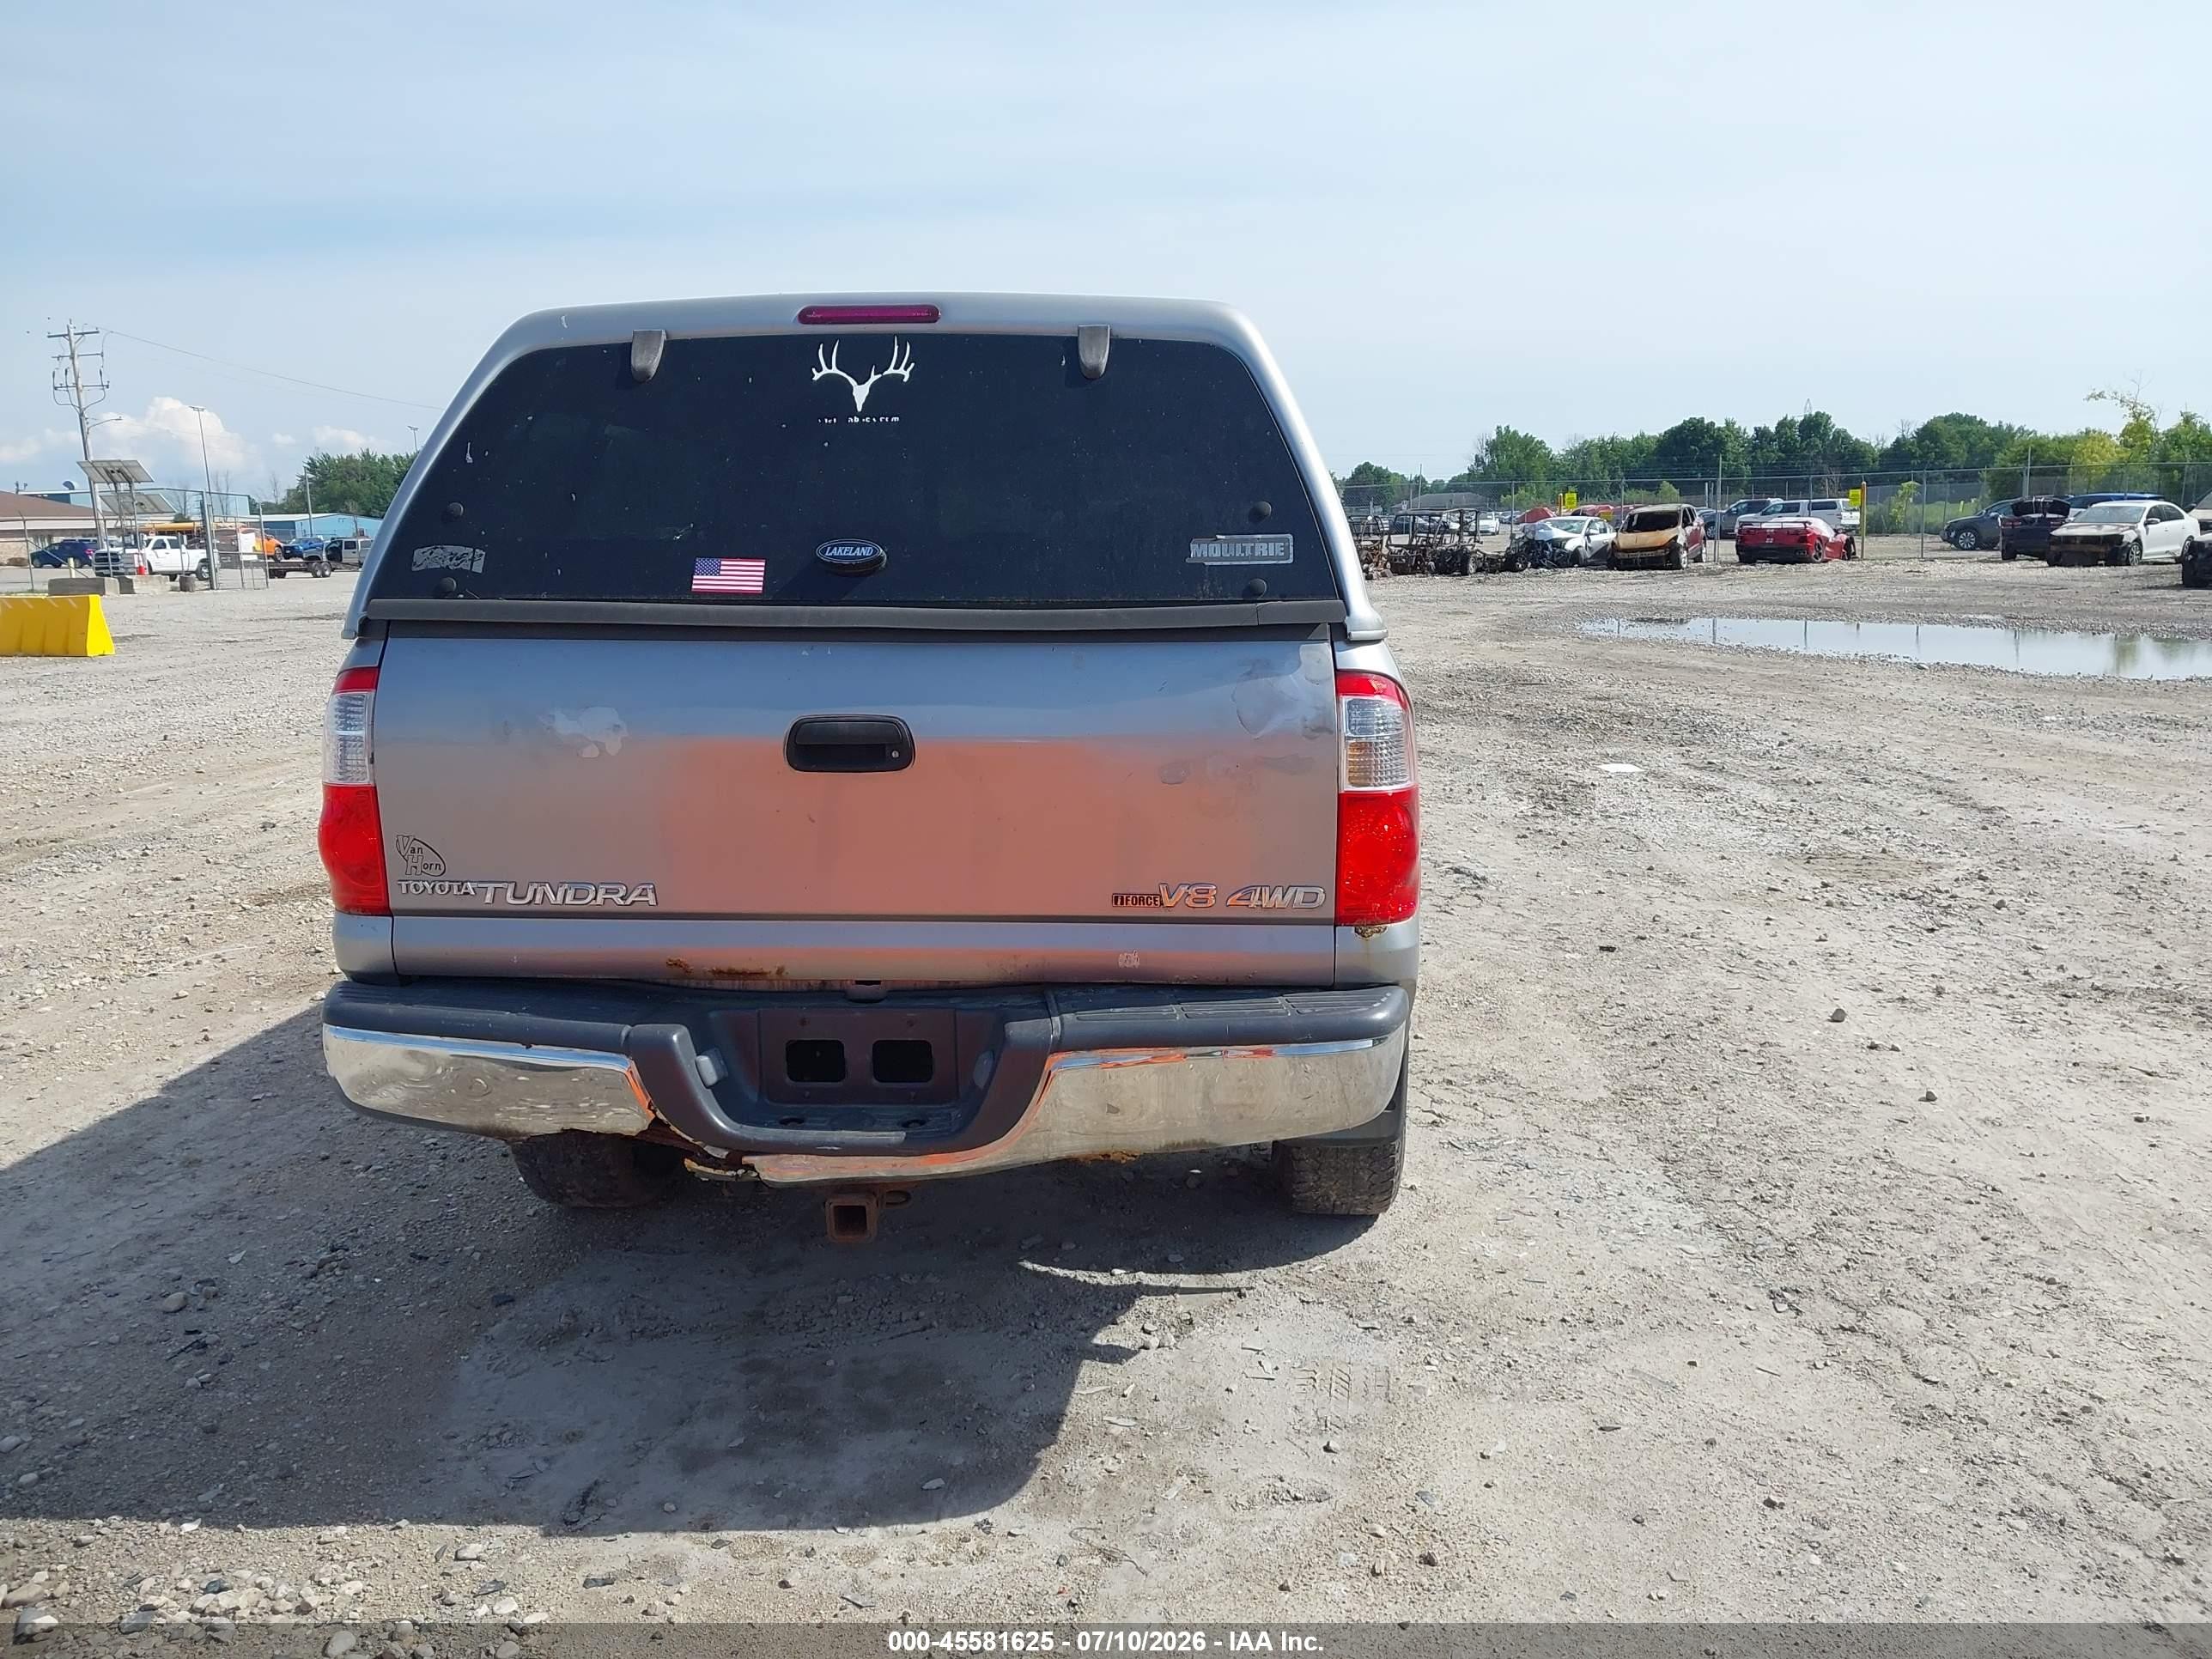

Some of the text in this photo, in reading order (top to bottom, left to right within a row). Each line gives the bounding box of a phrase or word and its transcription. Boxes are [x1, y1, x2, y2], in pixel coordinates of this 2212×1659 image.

[825, 546, 874, 556] LAKELAND
[1191, 542, 1285, 558] MOULTRIE
[397, 835, 423, 857] Van
[405, 854, 442, 876] Horn
[398, 879, 658, 906] TOYOTA TUNDRA
[1158, 883, 1217, 908] V8
[1226, 885, 1326, 908] 4WD
